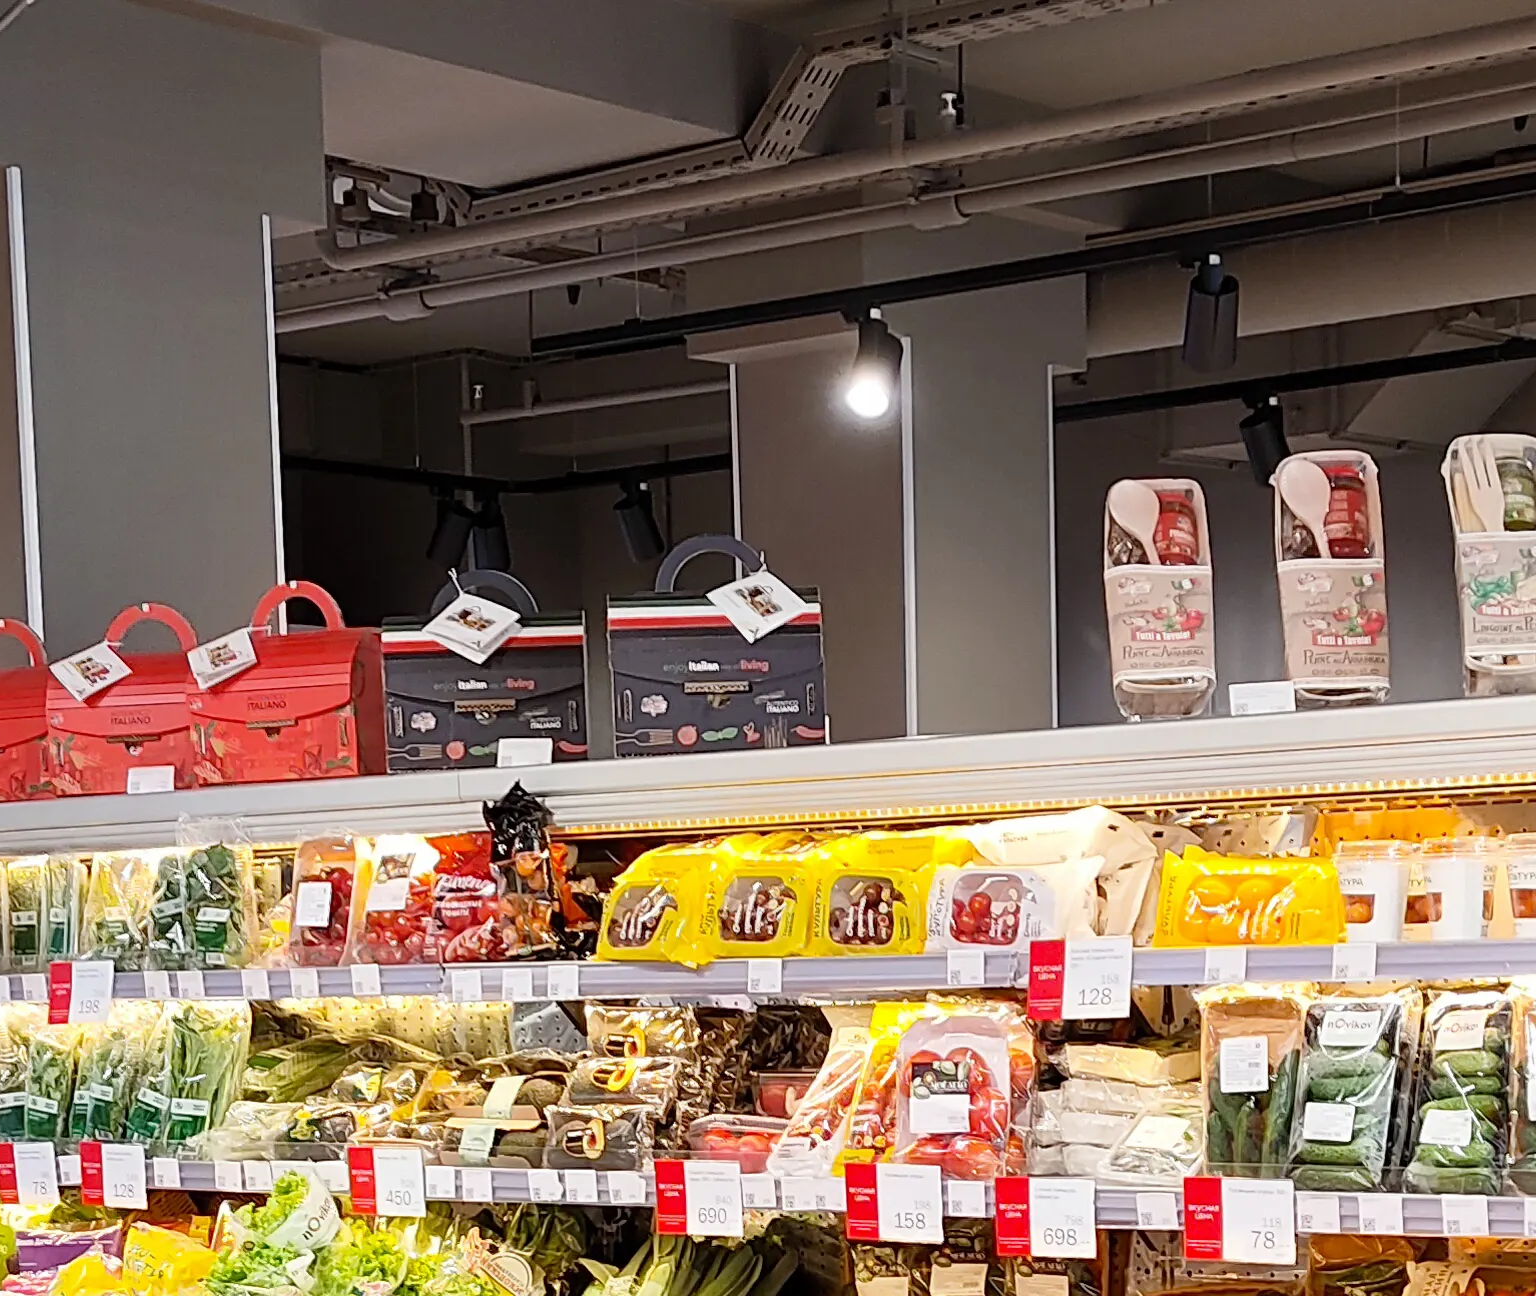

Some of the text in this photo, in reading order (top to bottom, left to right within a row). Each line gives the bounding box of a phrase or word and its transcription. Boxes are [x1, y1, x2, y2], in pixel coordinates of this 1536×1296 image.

[1077, 987, 1113, 1007] 128
[77, 999, 101, 1014] 198
[32, 1181, 48, 1195] 78
[113, 1183, 135, 1198] 128
[385, 1190, 412, 1206] 450
[697, 1207, 727, 1224] 690
[894, 1211, 927, 1229] 158
[1043, 1227, 1078, 1245] 698
[1250, 1229, 1276, 1249] 78
